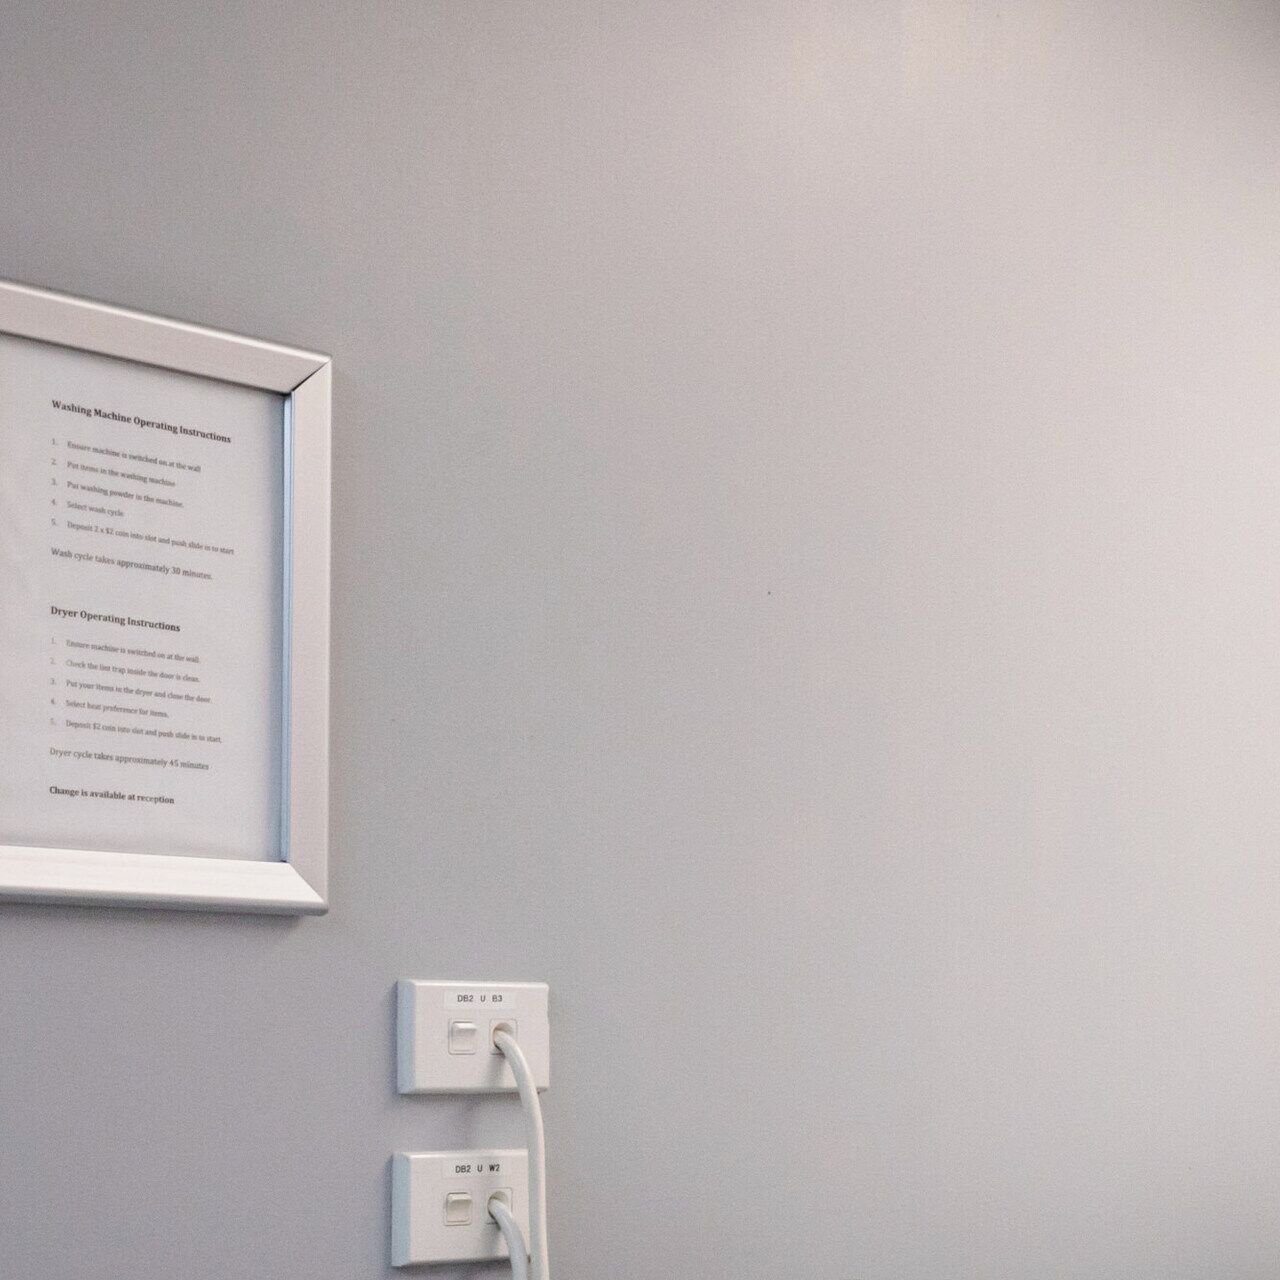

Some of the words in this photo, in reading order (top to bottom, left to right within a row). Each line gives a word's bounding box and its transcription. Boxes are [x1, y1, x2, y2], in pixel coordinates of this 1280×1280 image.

[52, 400, 92, 417] Washing
[94, 408, 131, 423] Machine
[134, 416, 178, 434] Operating
[180, 425, 231, 443] Instructions
[51, 547, 72, 558] Wash
[74, 553, 93, 561] cycle
[94, 555, 115, 565] takes
[116, 559, 170, 574] approximately
[171, 566, 181, 575] 30
[51, 606, 78, 618] Dryer
[80, 610, 126, 626] Operating
[127, 616, 181, 632] Instructions
[49, 747, 72, 758] Dryer
[73, 751, 93, 759] cycle
[93, 752, 114, 761] takes
[115, 755, 168, 768] approximately
[169, 759, 179, 767] 45
[49, 786, 79, 798] Change
[81, 789, 88, 797] is
[89, 790, 126, 801] available
[137, 795, 175, 805] reception
[457, 994, 474, 1002] DB2
[480, 994, 486, 1002] U
[455, 1165, 471, 1174] DB2
[477, 1164, 483, 1173] U
[489, 1163, 500, 1172] W2
